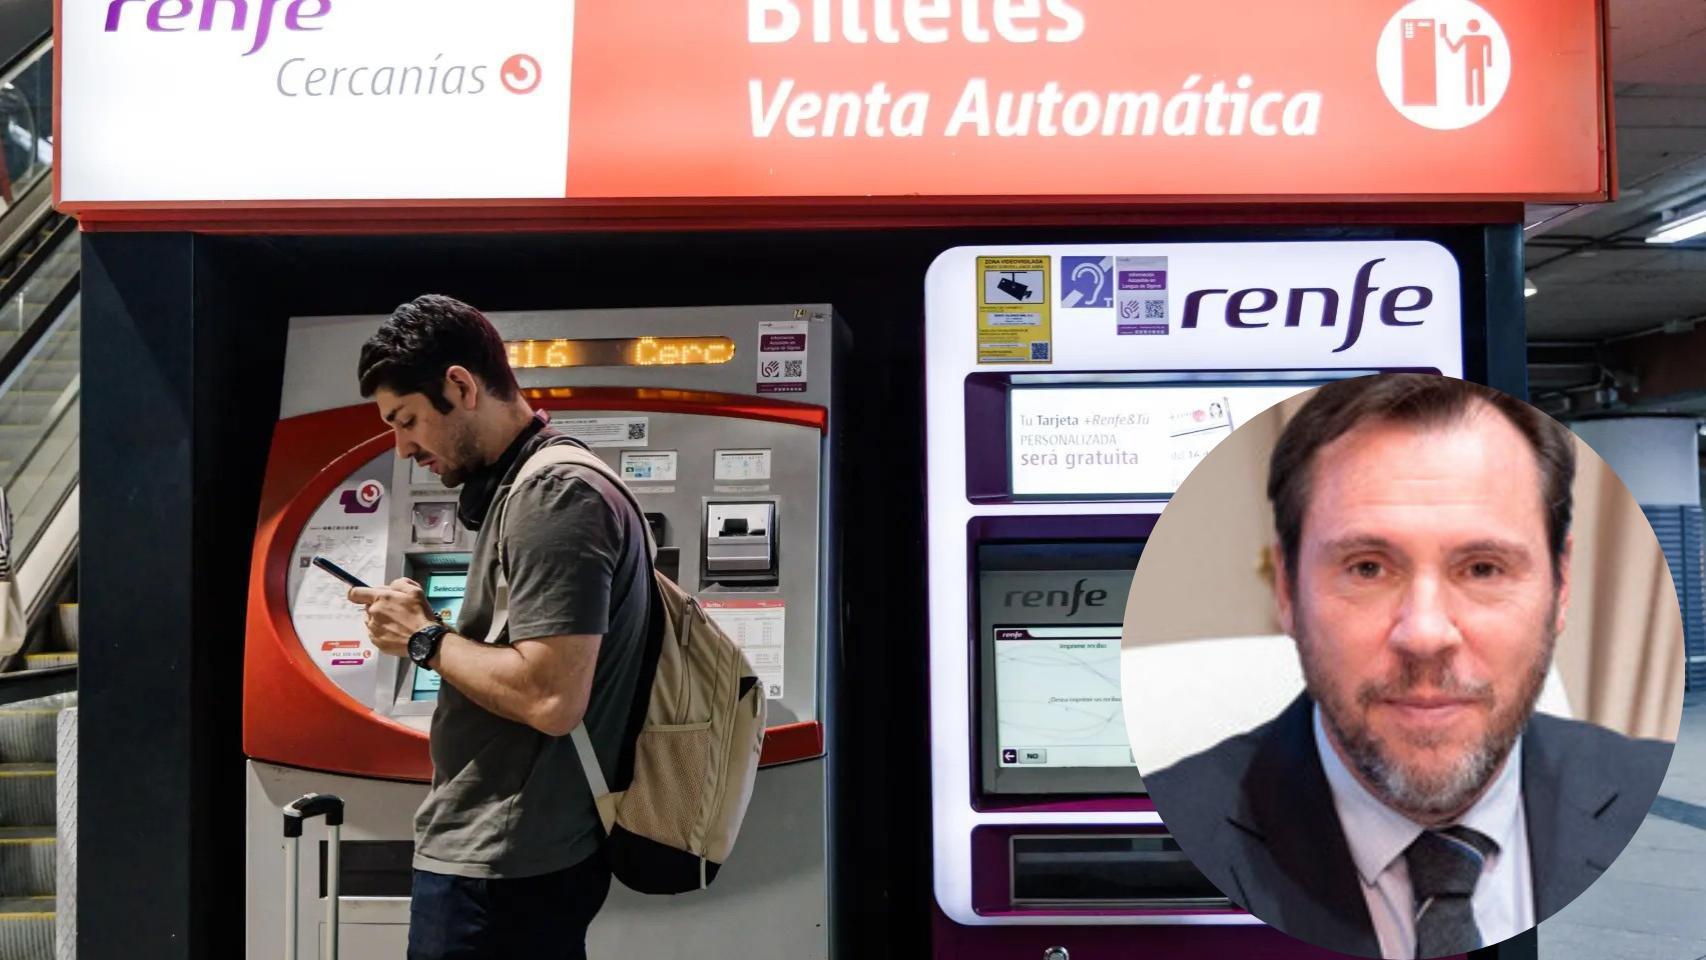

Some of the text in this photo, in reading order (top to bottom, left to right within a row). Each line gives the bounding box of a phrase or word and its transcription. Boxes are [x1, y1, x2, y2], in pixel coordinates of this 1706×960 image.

[104, 0, 332, 57] renfe
[747, 0, 1085, 43] Billetes
[276, 53, 488, 97] Cercanías
[748, 73, 1323, 138] Venta Automática
[1103, 297, 1113, 307] T
[1181, 257, 1434, 354] renfe
[636, 336, 735, 365] Cerc
[1020, 414, 1150, 428] Tu Tarjeta +Renfe&Tu
[1020, 434, 1118, 447] PERSONALIZADA
[1020, 449, 1138, 469] será gratuita
[1003, 578, 1108, 618] renfe
[1002, 631, 1023, 640] renfe
